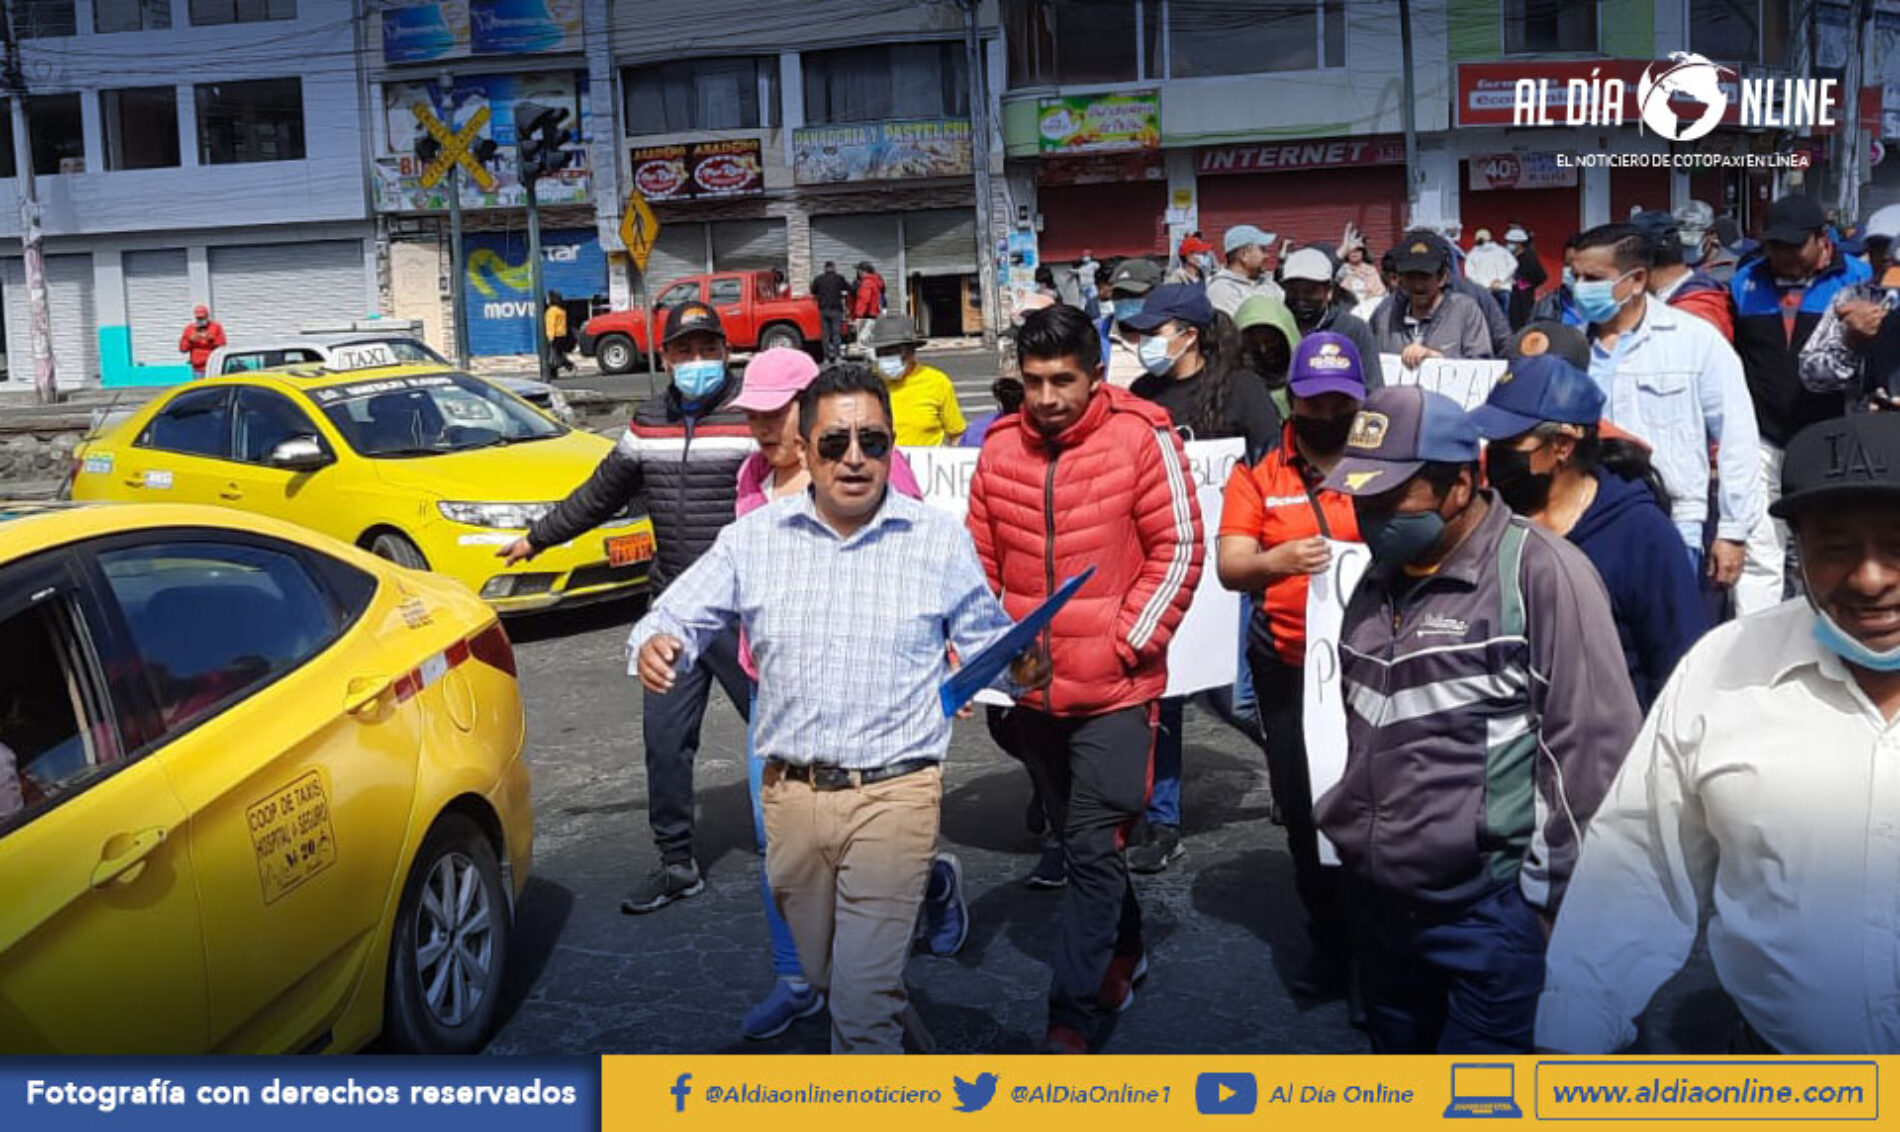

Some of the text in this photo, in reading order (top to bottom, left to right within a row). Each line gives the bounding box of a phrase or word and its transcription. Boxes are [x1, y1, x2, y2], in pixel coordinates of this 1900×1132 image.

[1201, 142, 1370, 169] INTERNET
[343, 348, 388, 368] TAXI
[280, 793, 295, 815] DE
